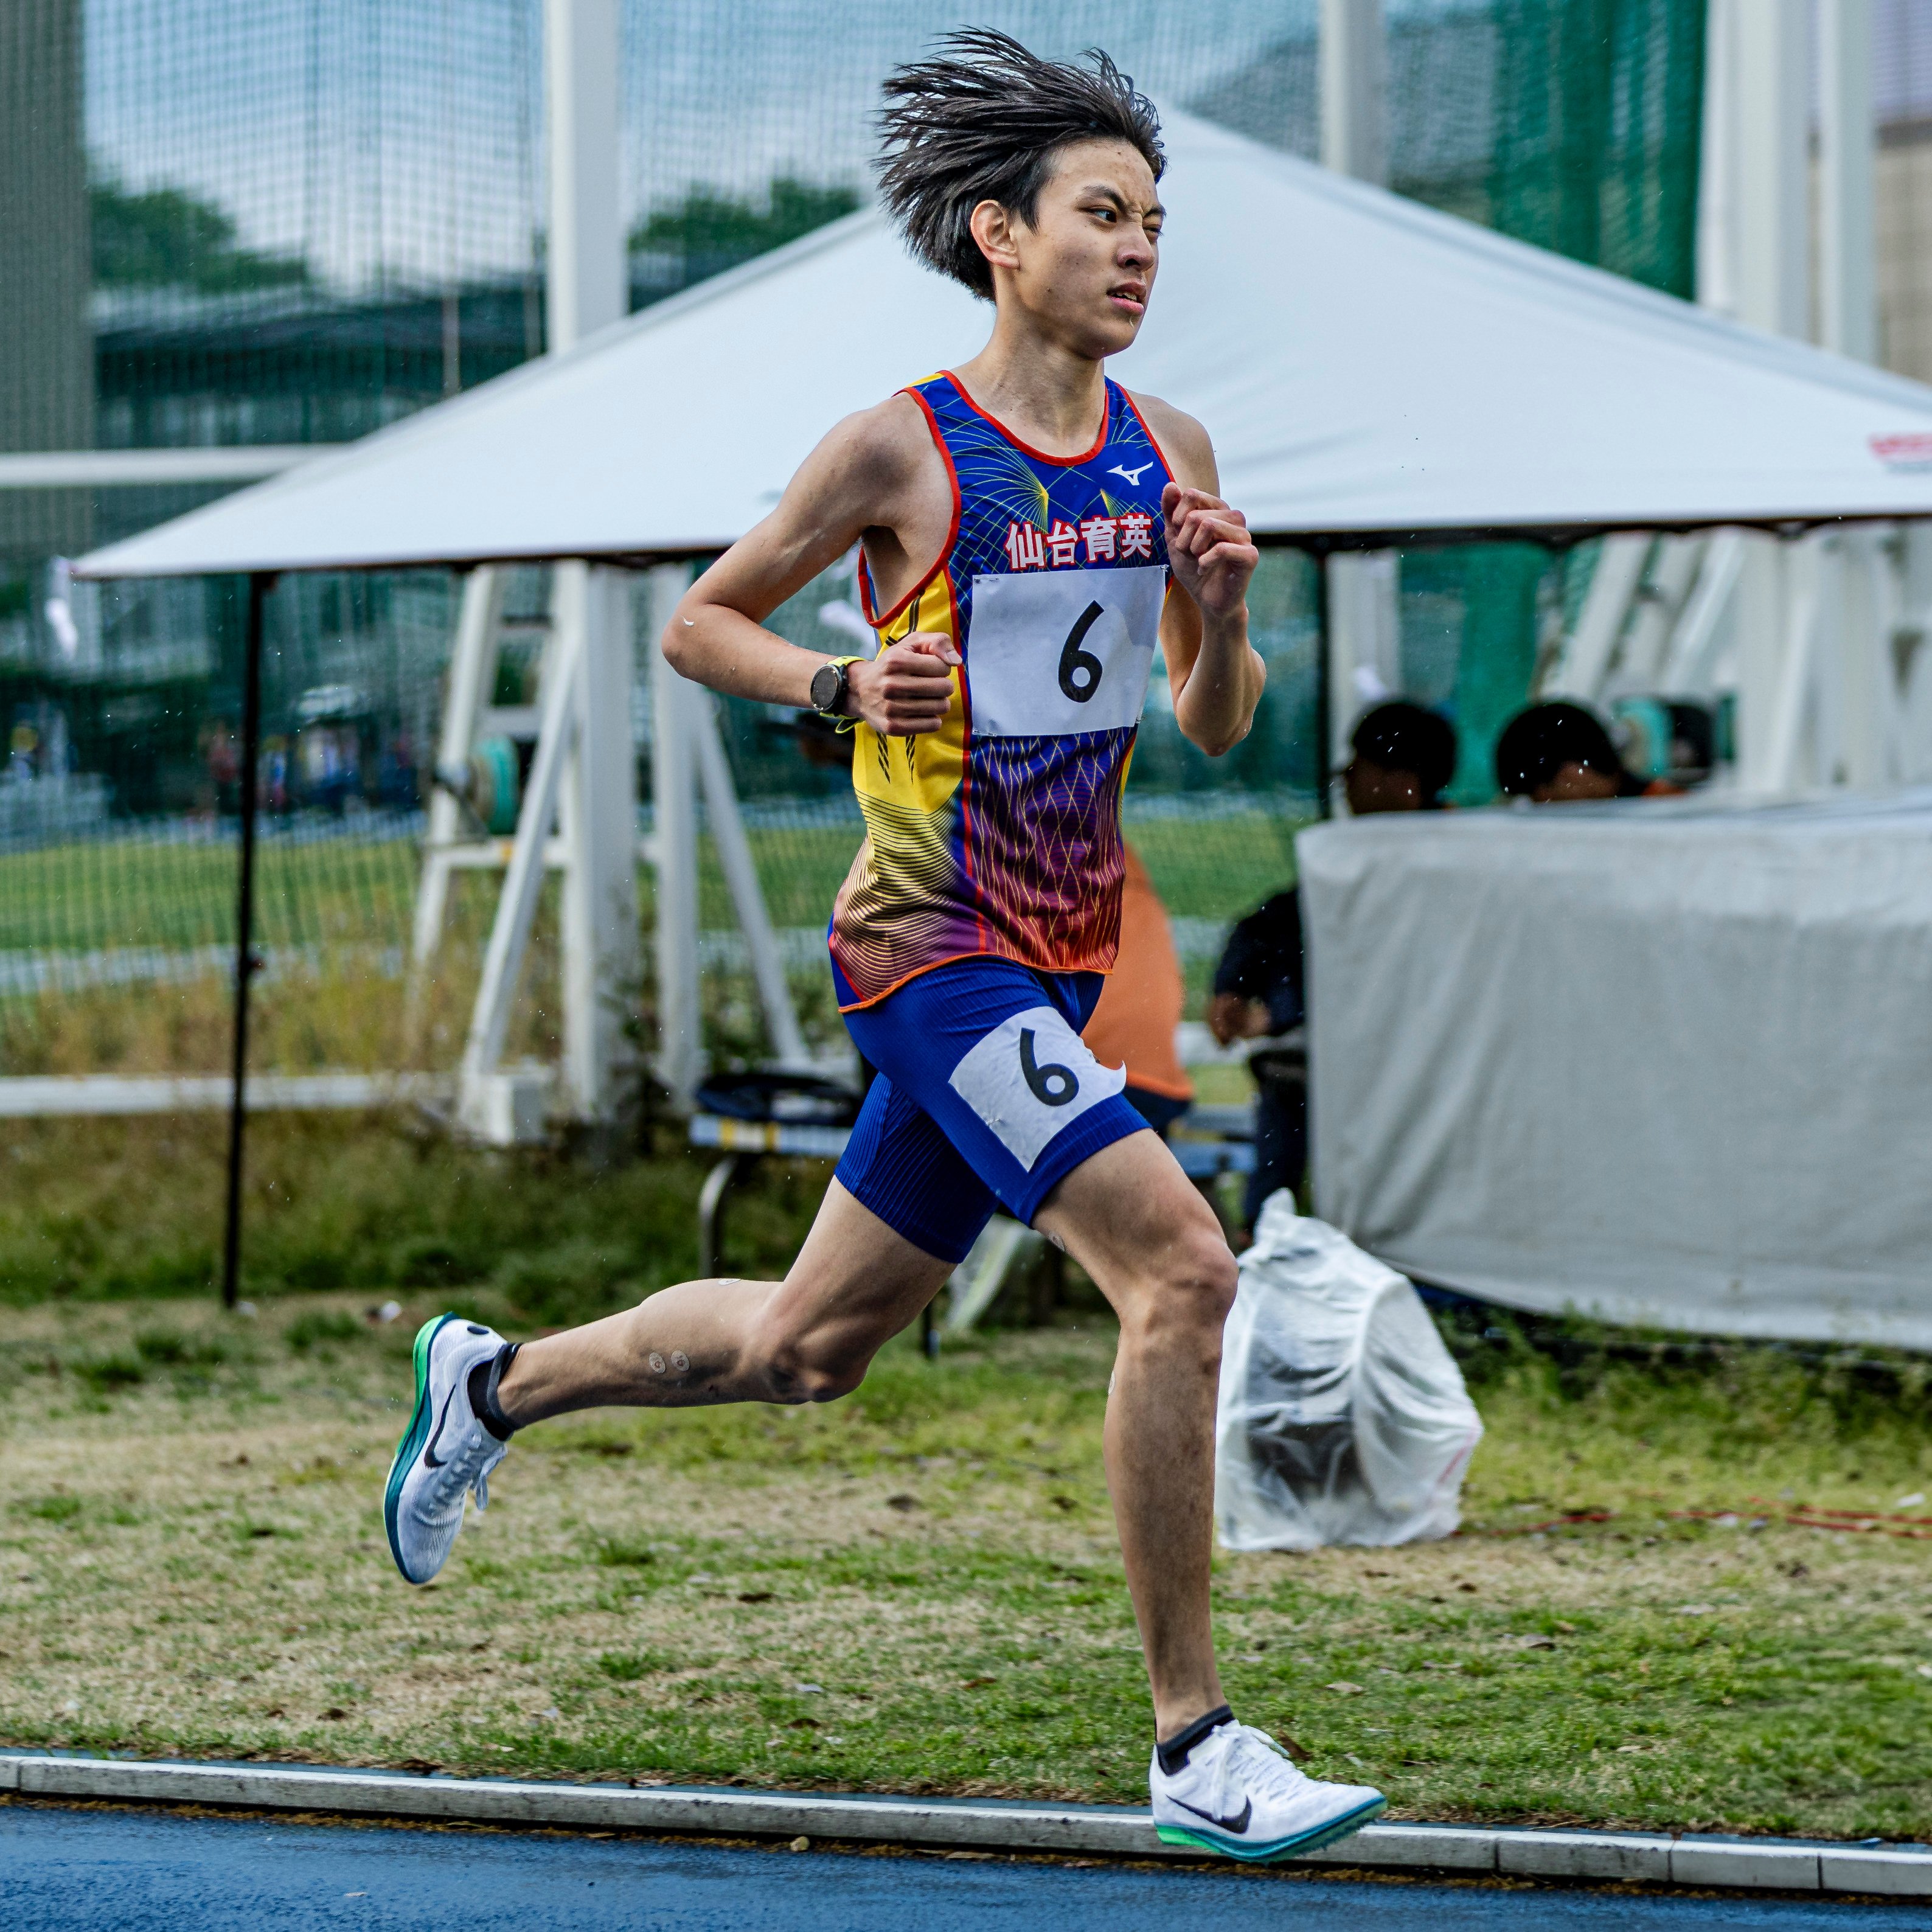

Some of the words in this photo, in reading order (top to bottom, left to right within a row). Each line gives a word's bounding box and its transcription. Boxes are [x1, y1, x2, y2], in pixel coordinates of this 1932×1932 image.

[1004, 513, 1153, 570] 仙台育英
[1058, 600, 1104, 703] 6
[1020, 1027, 1080, 1107] 6
